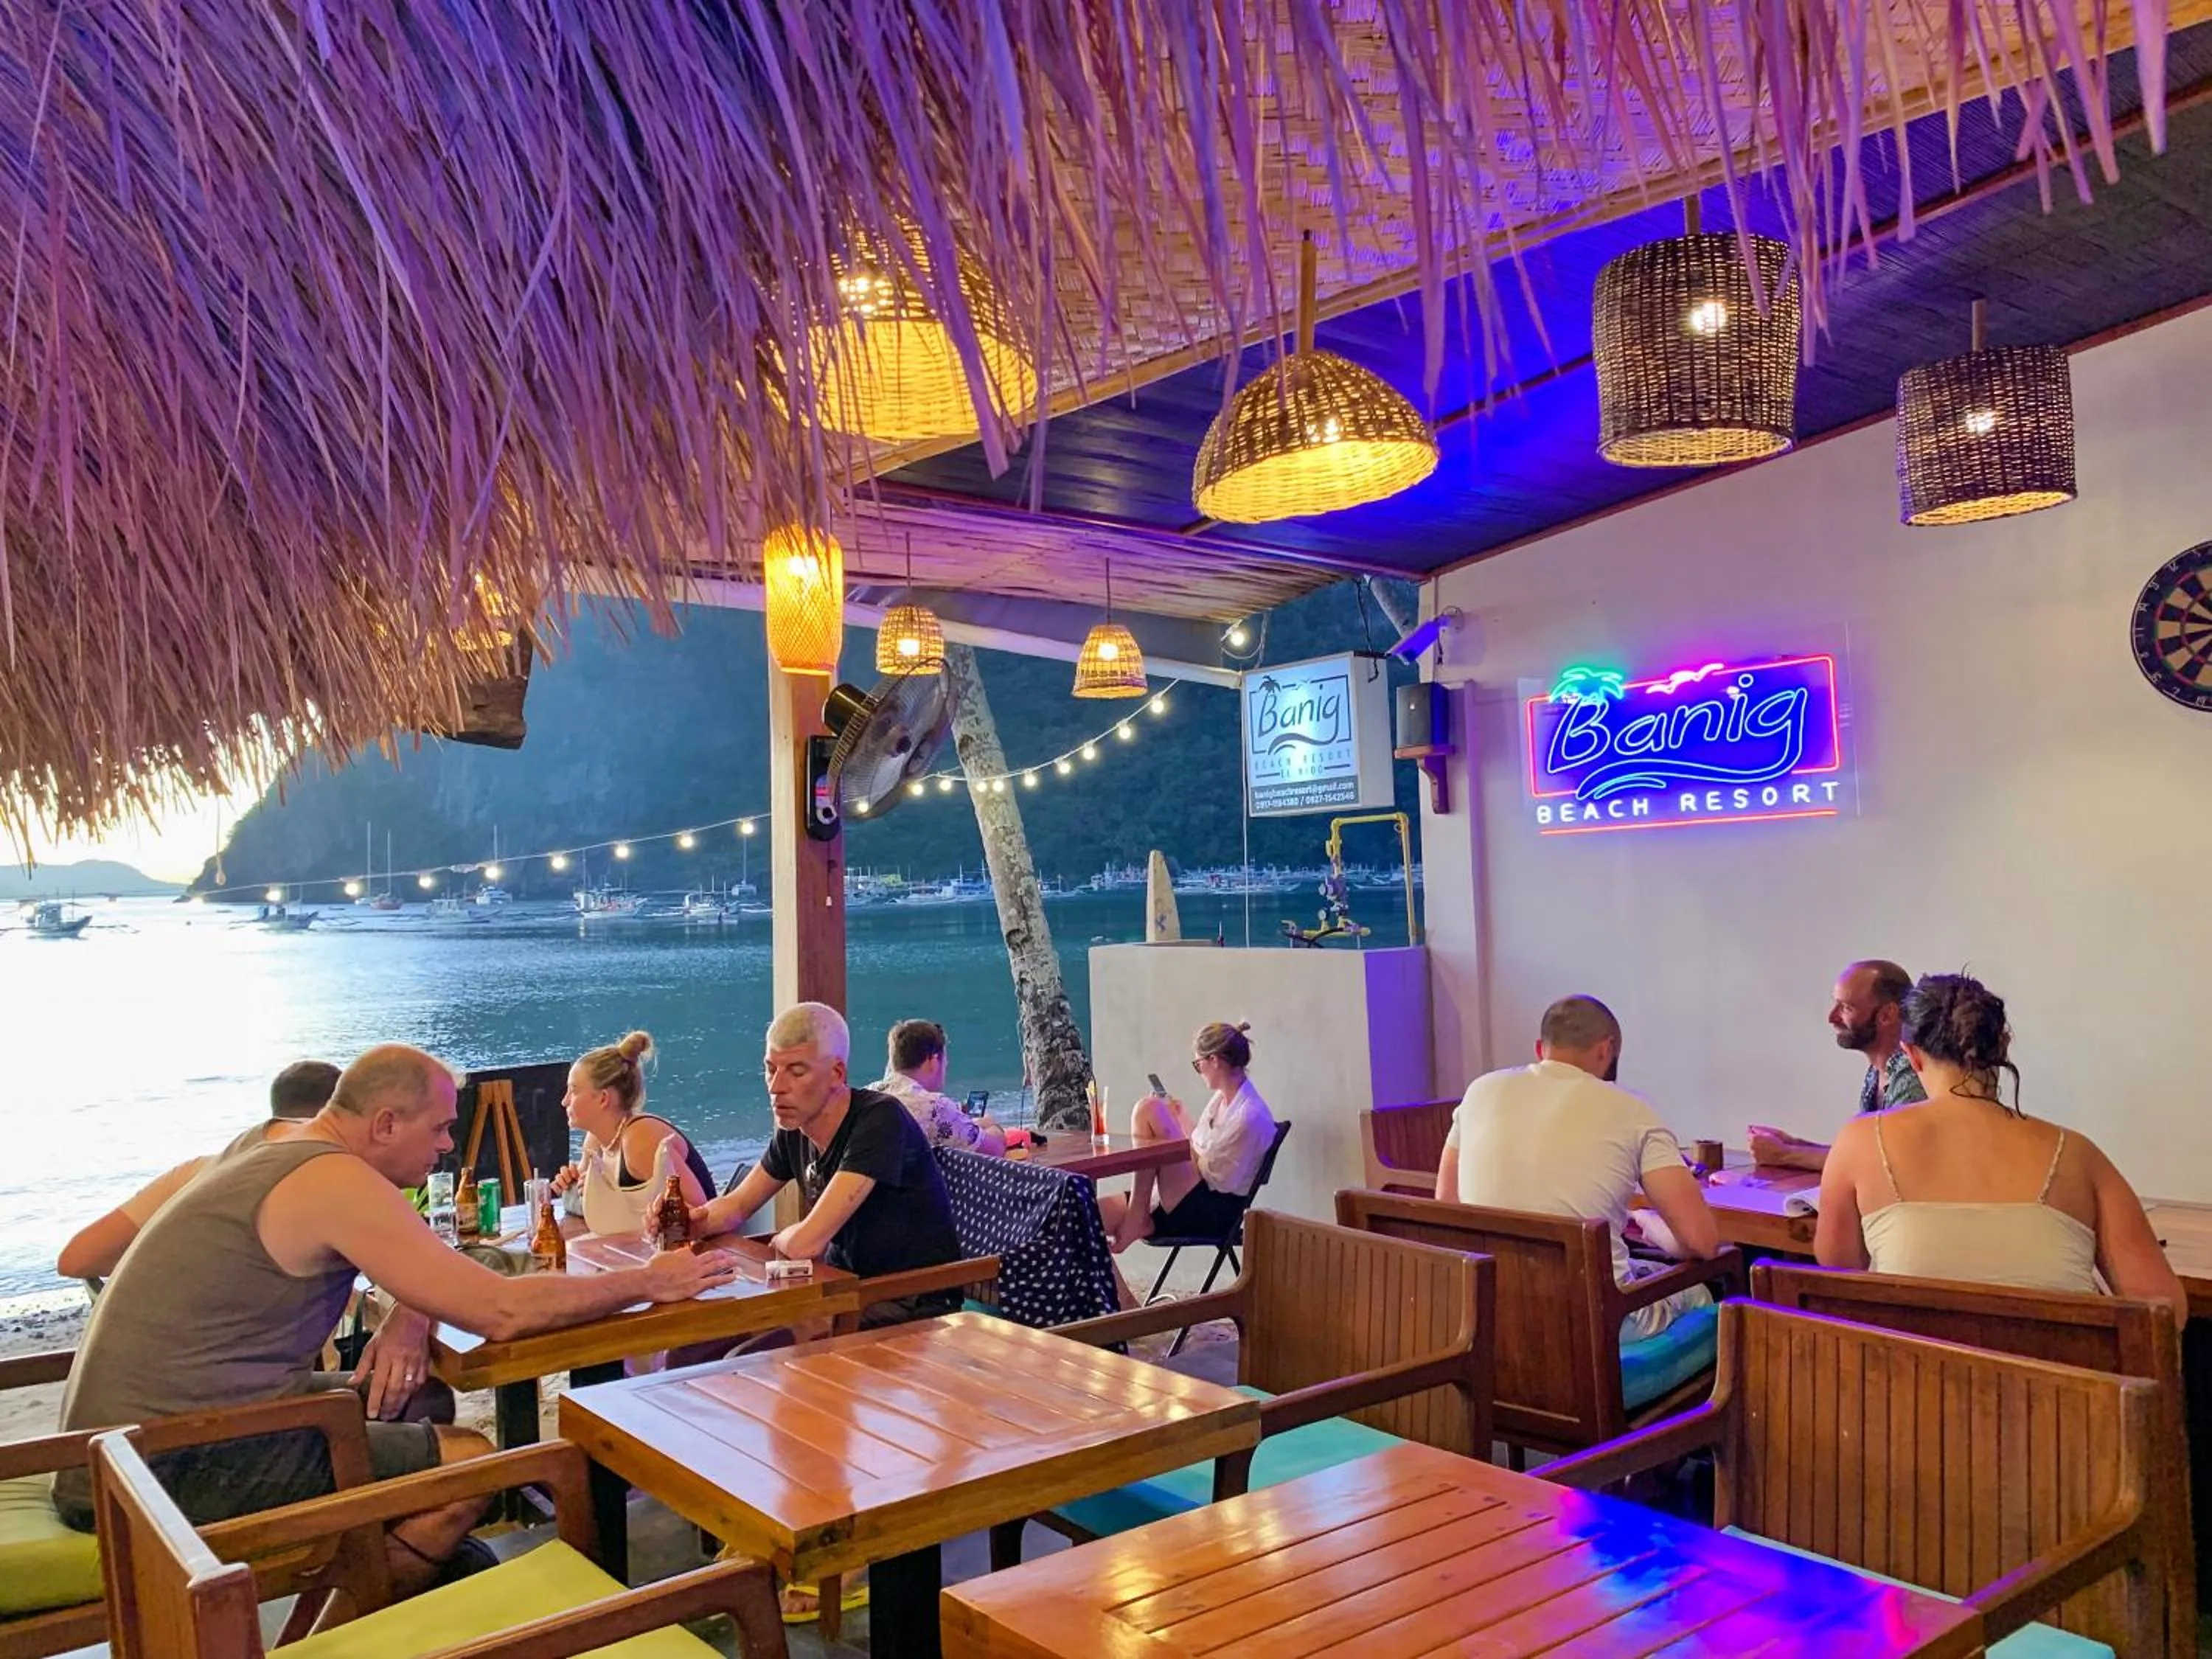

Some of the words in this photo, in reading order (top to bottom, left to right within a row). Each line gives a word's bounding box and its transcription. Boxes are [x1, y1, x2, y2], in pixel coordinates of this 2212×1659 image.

[1258, 684, 1340, 745] Banig
[1548, 674, 1808, 783] Banig
[1255, 757, 1290, 771] BEACH
[1303, 749, 1351, 763] RESORT
[1537, 797, 1649, 824] BEACH
[1680, 781, 1841, 812] RESORT
